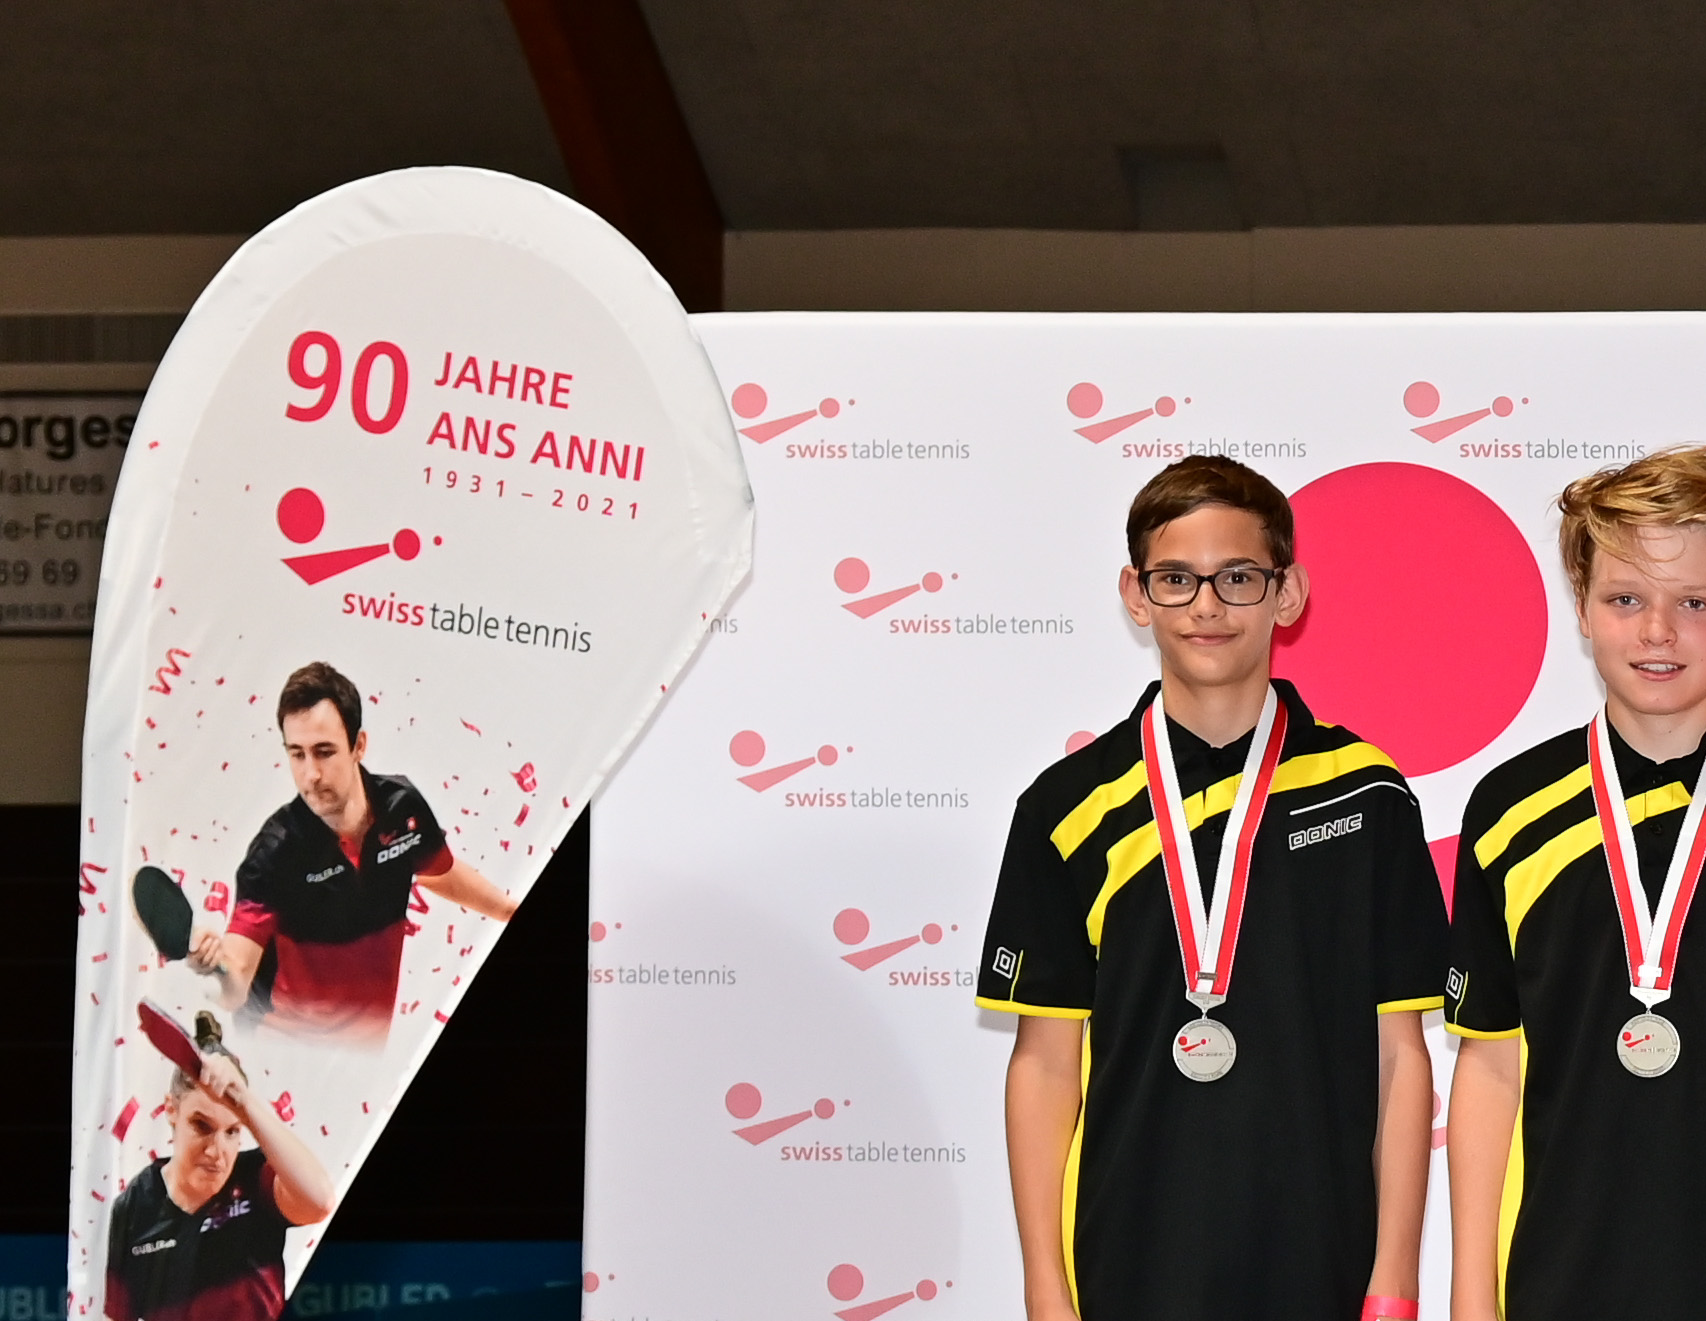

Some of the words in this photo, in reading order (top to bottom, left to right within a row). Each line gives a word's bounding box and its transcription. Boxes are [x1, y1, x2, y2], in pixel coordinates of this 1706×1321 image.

[285, 330, 408, 434] 90
[434, 351, 573, 410] JAHRE
[426, 411, 517, 459] ANS
[530, 431, 645, 481] ANNI
[342, 592, 424, 626] swiss
[430, 603, 499, 639] table
[505, 615, 592, 652] tennis
[1289, 812, 1363, 850] DONIC
